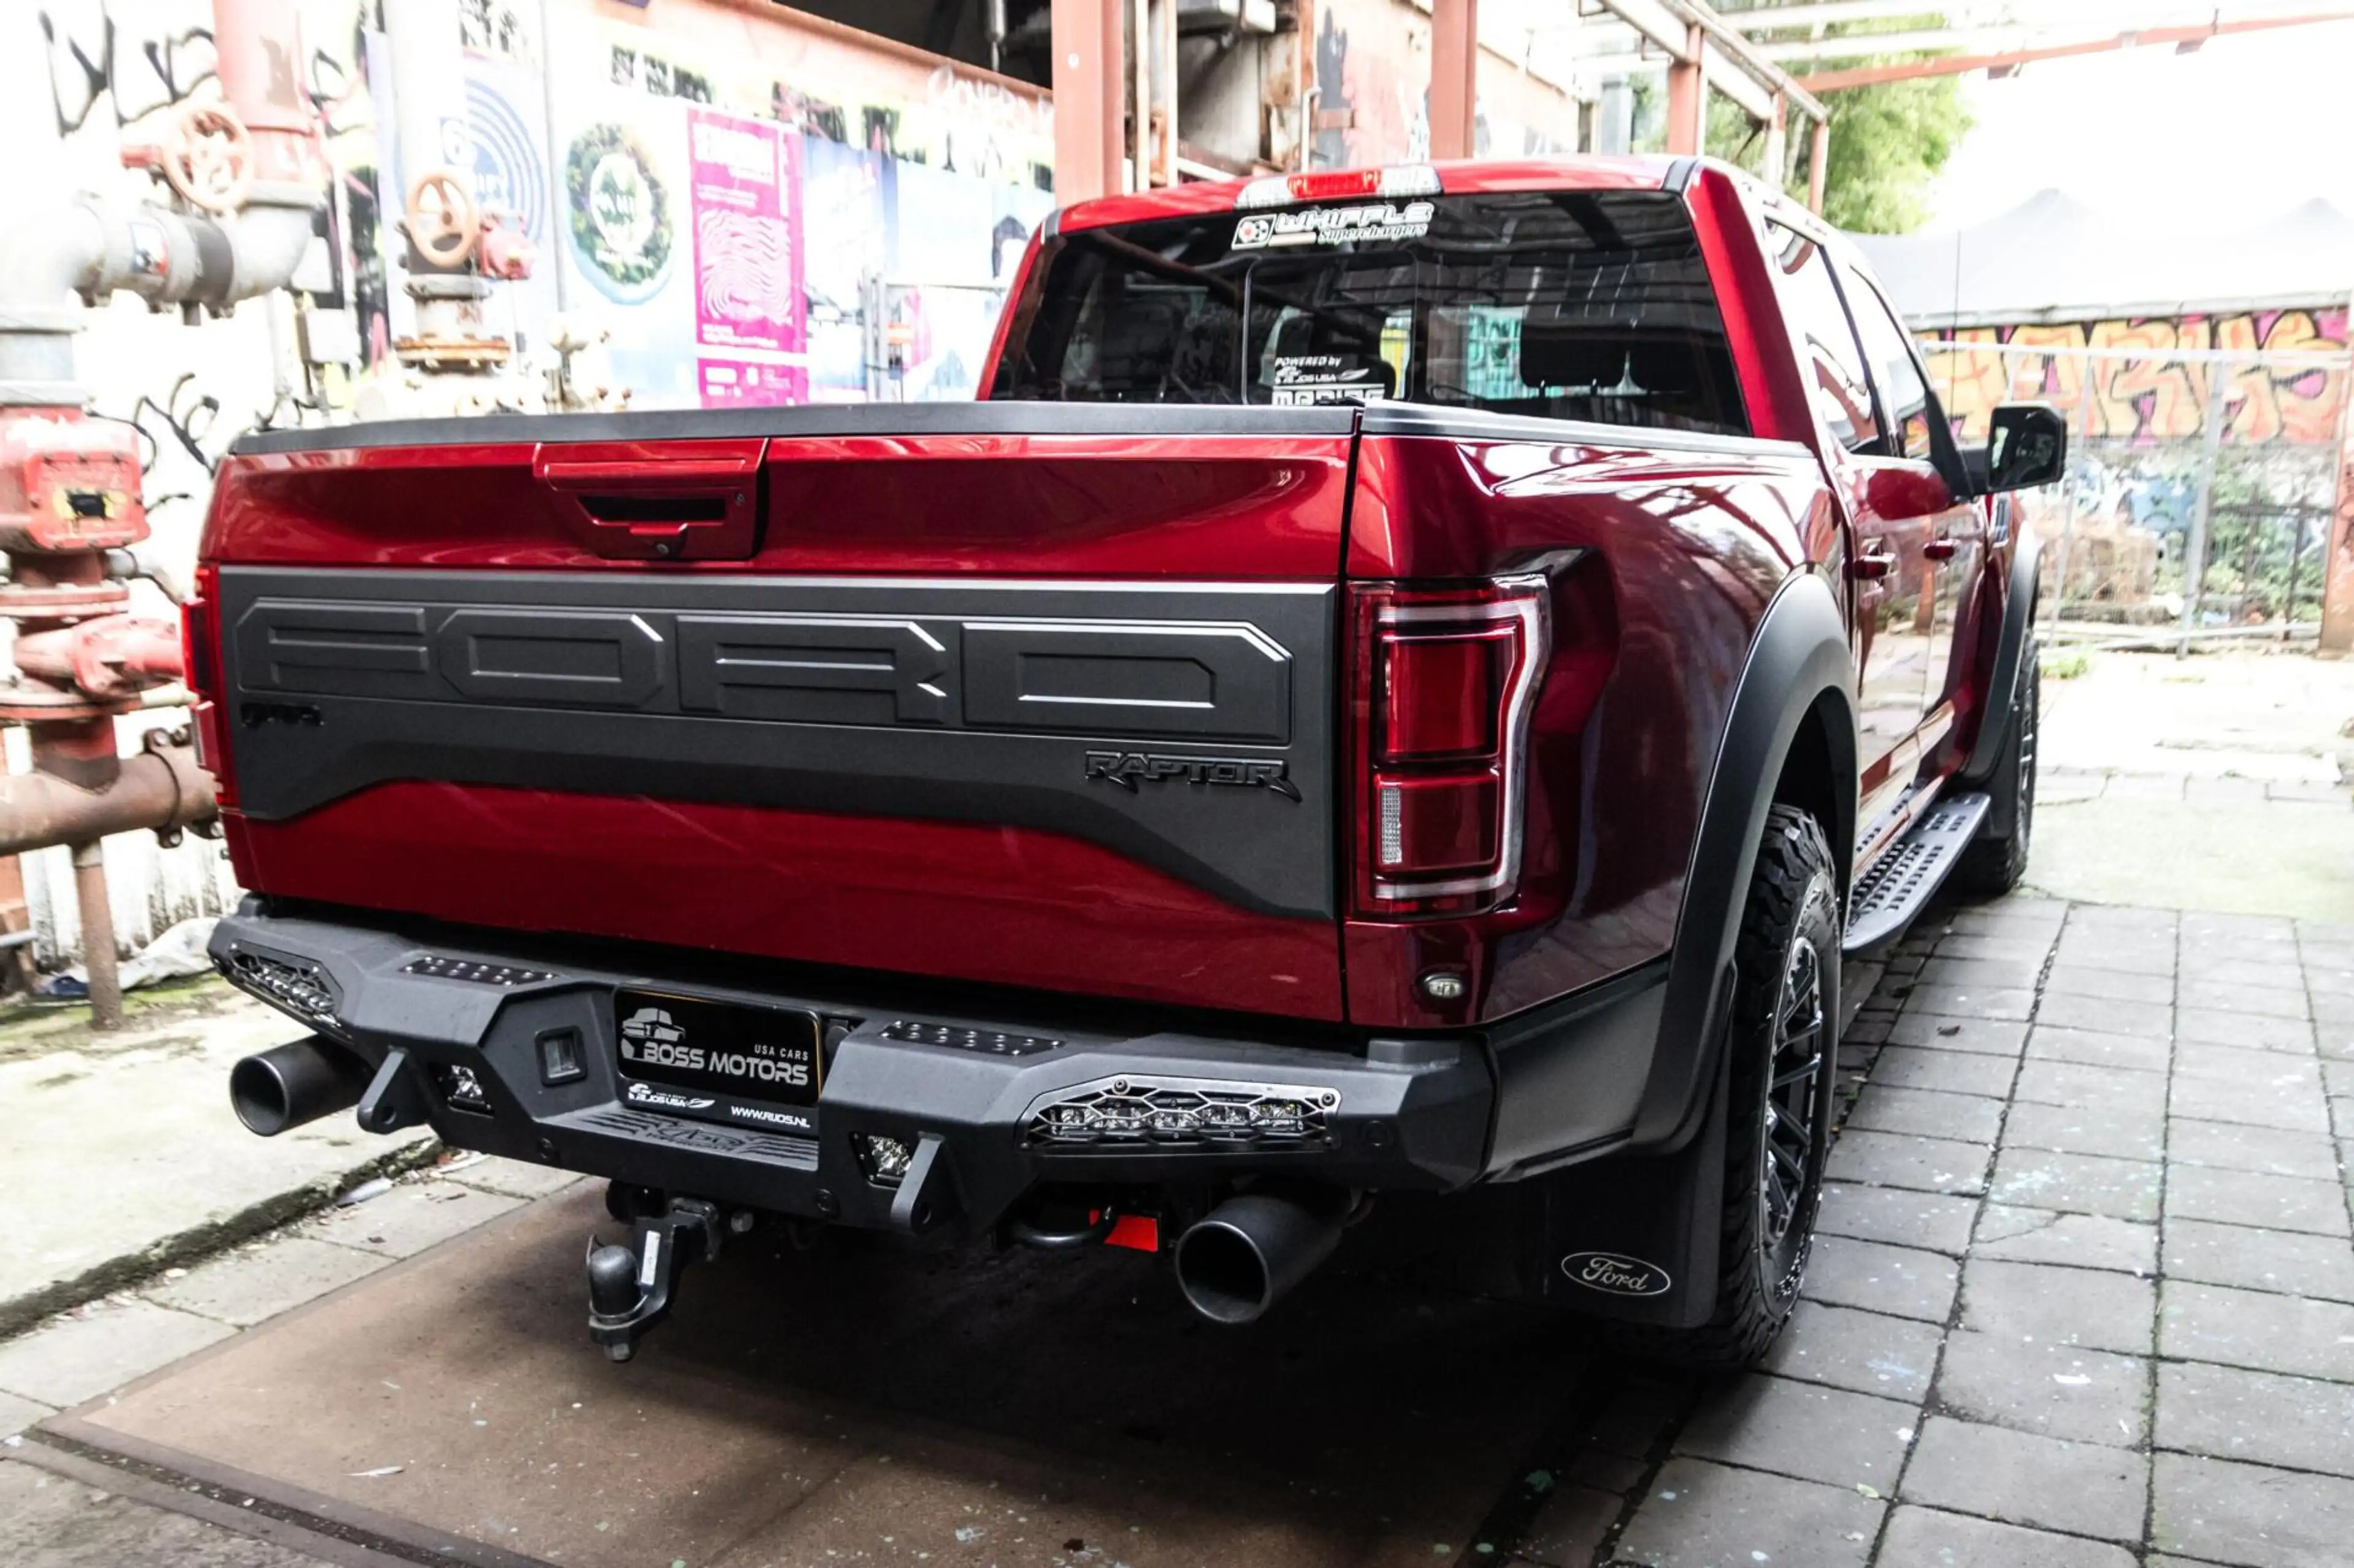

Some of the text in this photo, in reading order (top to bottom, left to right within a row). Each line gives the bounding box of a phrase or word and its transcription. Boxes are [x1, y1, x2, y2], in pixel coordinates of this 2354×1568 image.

[1276, 203, 1434, 234] WHIPPLE
[1275, 356, 1341, 367] POWERED by
[237, 602, 1290, 740] FORD
[1085, 750, 1303, 803] RAPTOR
[644, 1041, 809, 1086] BOSS MOTORS
[754, 1044, 809, 1061] USA CARS
[1582, 1257, 1649, 1290] Ford
